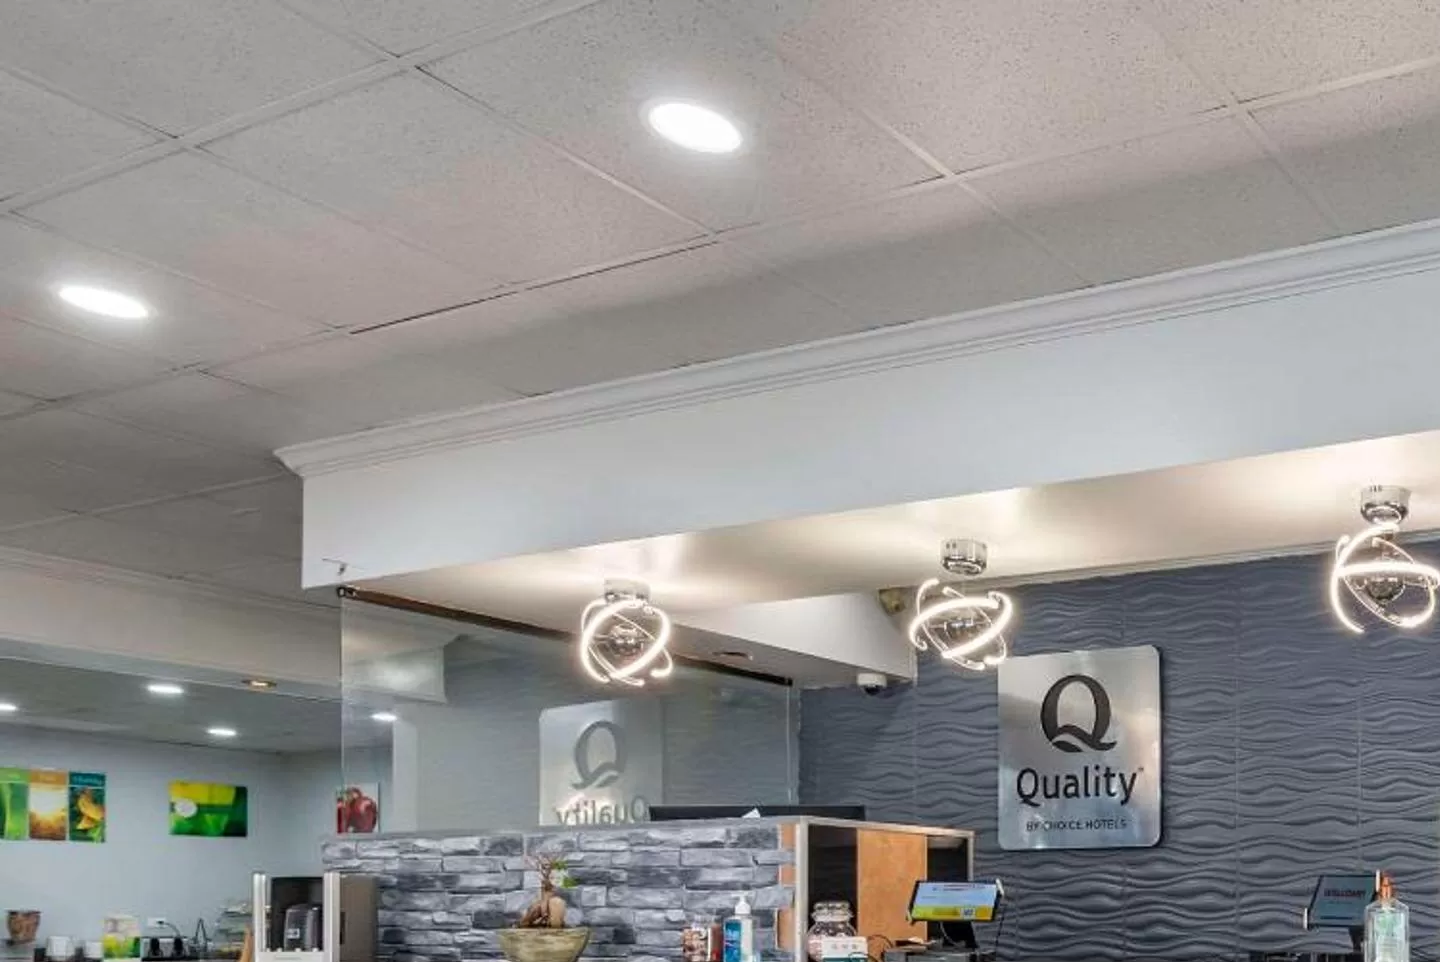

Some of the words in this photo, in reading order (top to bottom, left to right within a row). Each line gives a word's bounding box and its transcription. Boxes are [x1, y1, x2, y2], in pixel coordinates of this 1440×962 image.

[1015, 764, 1138, 808] Quality
[1042, 818, 1083, 832] CHOICE
[1085, 818, 1128, 831] HOTELS
